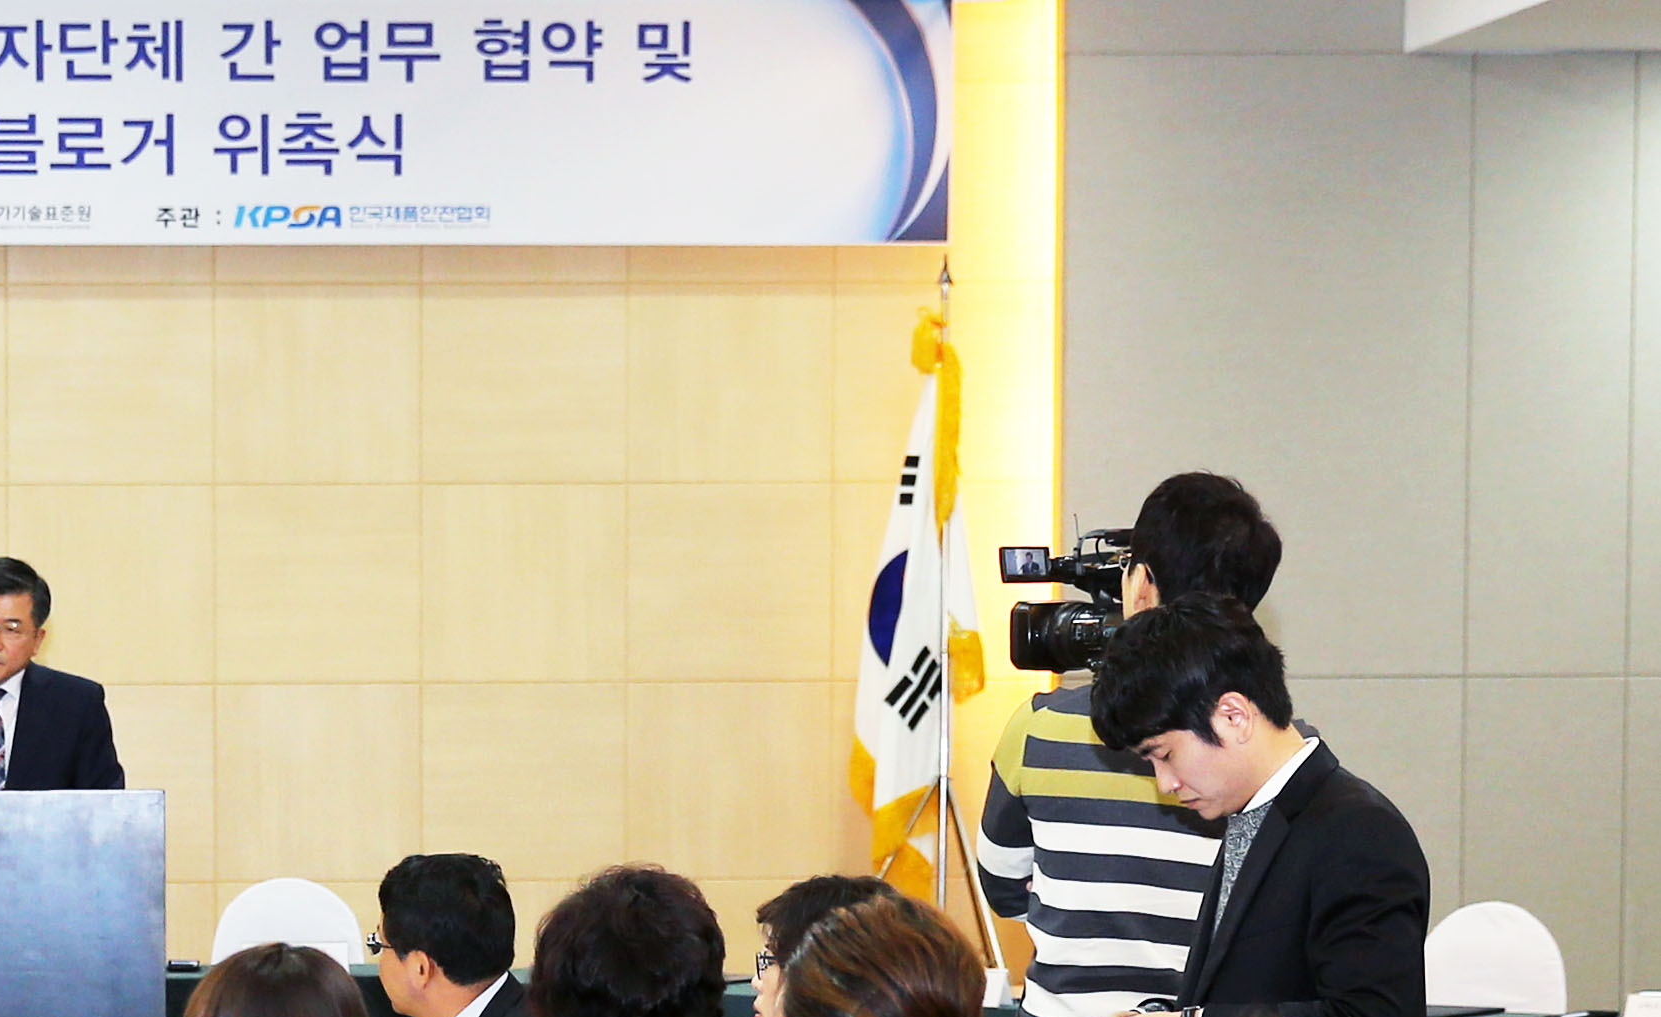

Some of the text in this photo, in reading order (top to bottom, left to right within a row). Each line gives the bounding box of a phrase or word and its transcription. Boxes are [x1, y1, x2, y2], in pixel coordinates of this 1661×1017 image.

[220, 18, 282, 83] 간
[314, 18, 442, 83] 업무
[473, 18, 604, 83] 협약
[637, 19, 693, 83] 및
[213, 111, 404, 176] 위촉식
[155, 207, 201, 229] 주관
[234, 205, 342, 229] KPSA
